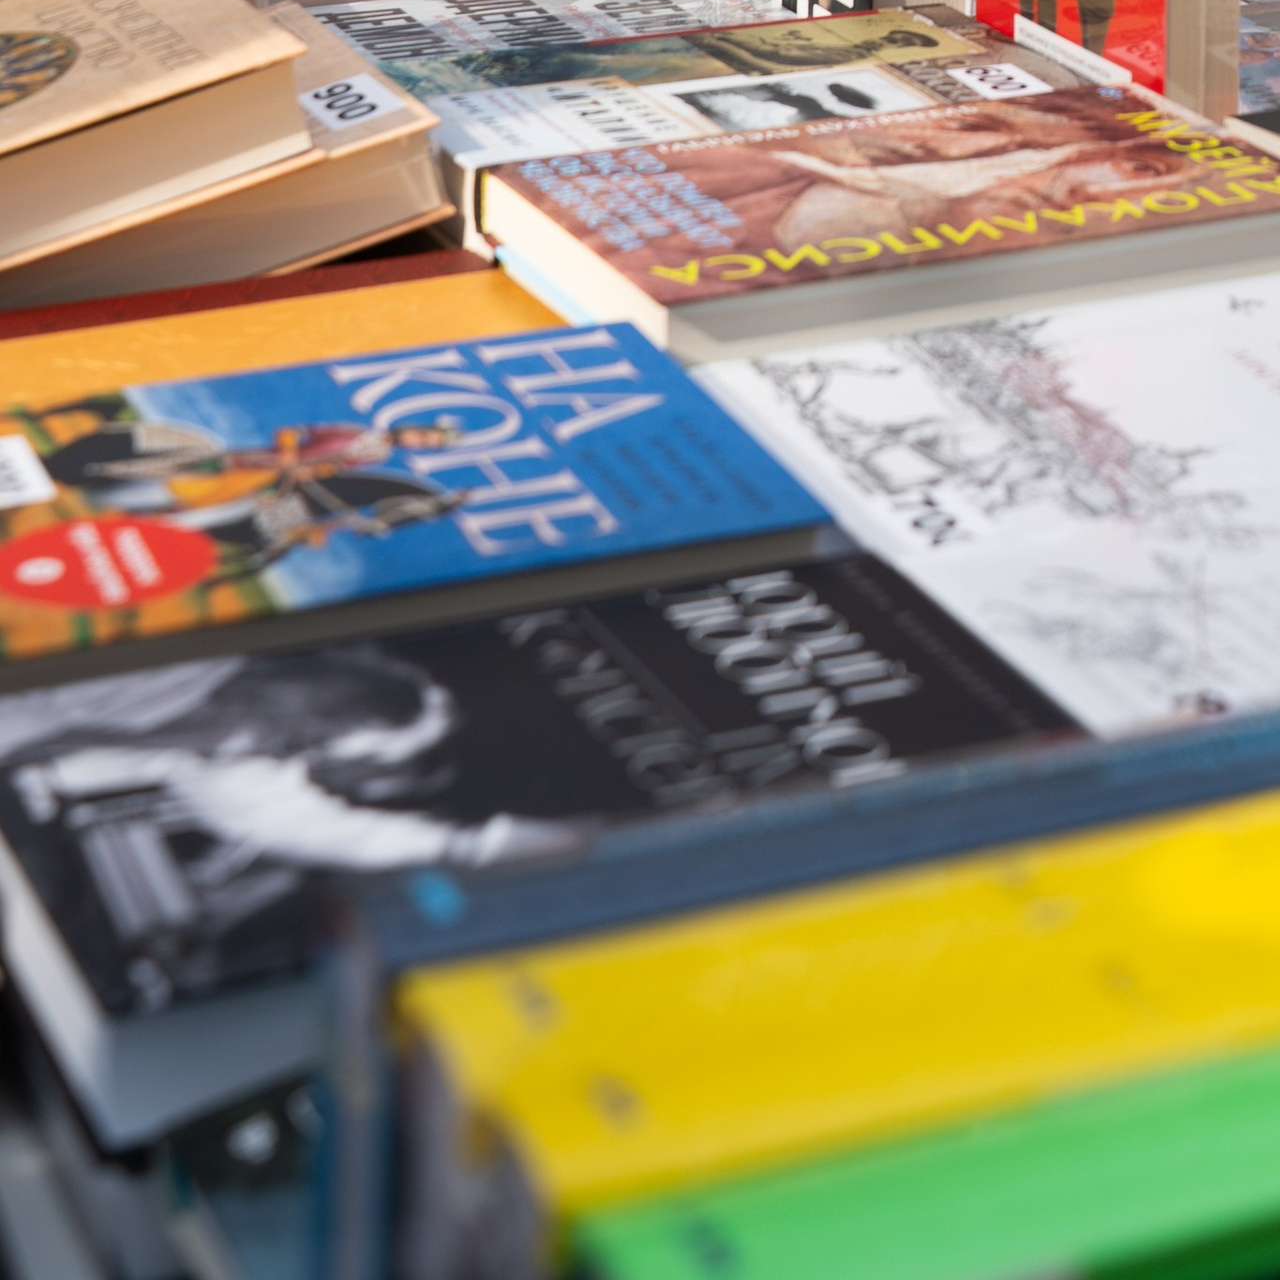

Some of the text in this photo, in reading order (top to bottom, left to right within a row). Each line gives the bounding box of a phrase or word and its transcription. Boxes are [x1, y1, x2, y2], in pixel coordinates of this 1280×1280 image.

[313, 83, 378, 121] 900
[966, 65, 1028, 91] 600
[1115, 108, 1280, 180] МУЗЕЙ
[476, 328, 664, 443] НА
[331, 348, 618, 557] КОНЕ
